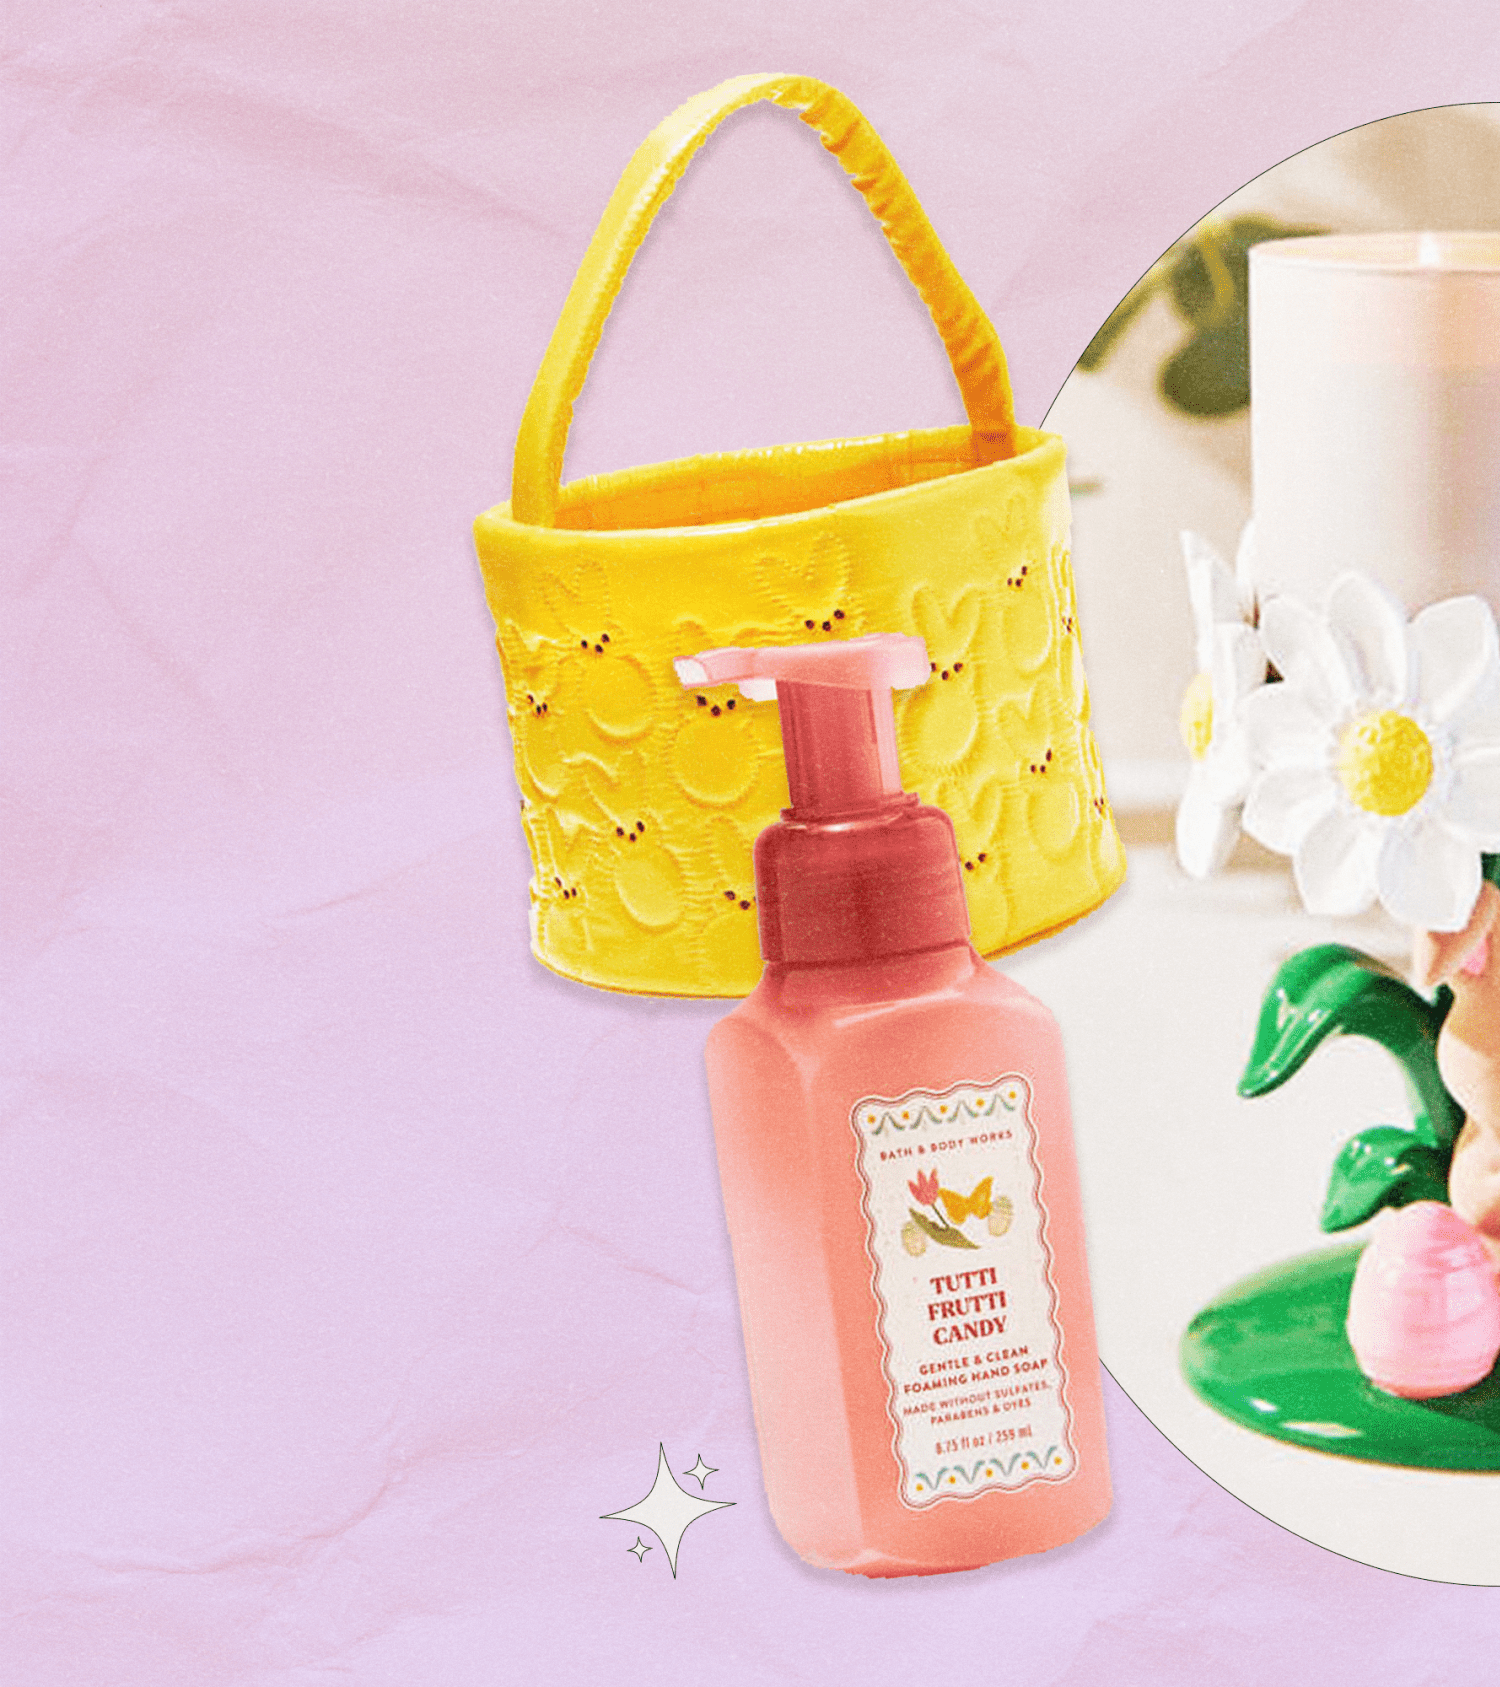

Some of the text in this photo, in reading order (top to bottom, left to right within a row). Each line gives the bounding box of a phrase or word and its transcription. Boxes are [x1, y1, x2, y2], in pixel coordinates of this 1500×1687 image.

[880, 1130, 1013, 1161] BATH & BODY WORKS
[930, 1267, 997, 1294] TUTTI
[927, 1290, 1007, 1321] FRUTTI
[933, 1315, 1007, 1345] CANDY
[919, 1345, 1029, 1375] GENTLE & CLEAN
[904, 1359, 1047, 1393] FOAMING HAND SOAP
[903, 1402, 935, 1415] MADE
[940, 1392, 991, 1409] WITHOUT
[930, 1397, 1031, 1424] PARABENS & DYES
[973, 1436, 985, 1447] oz
